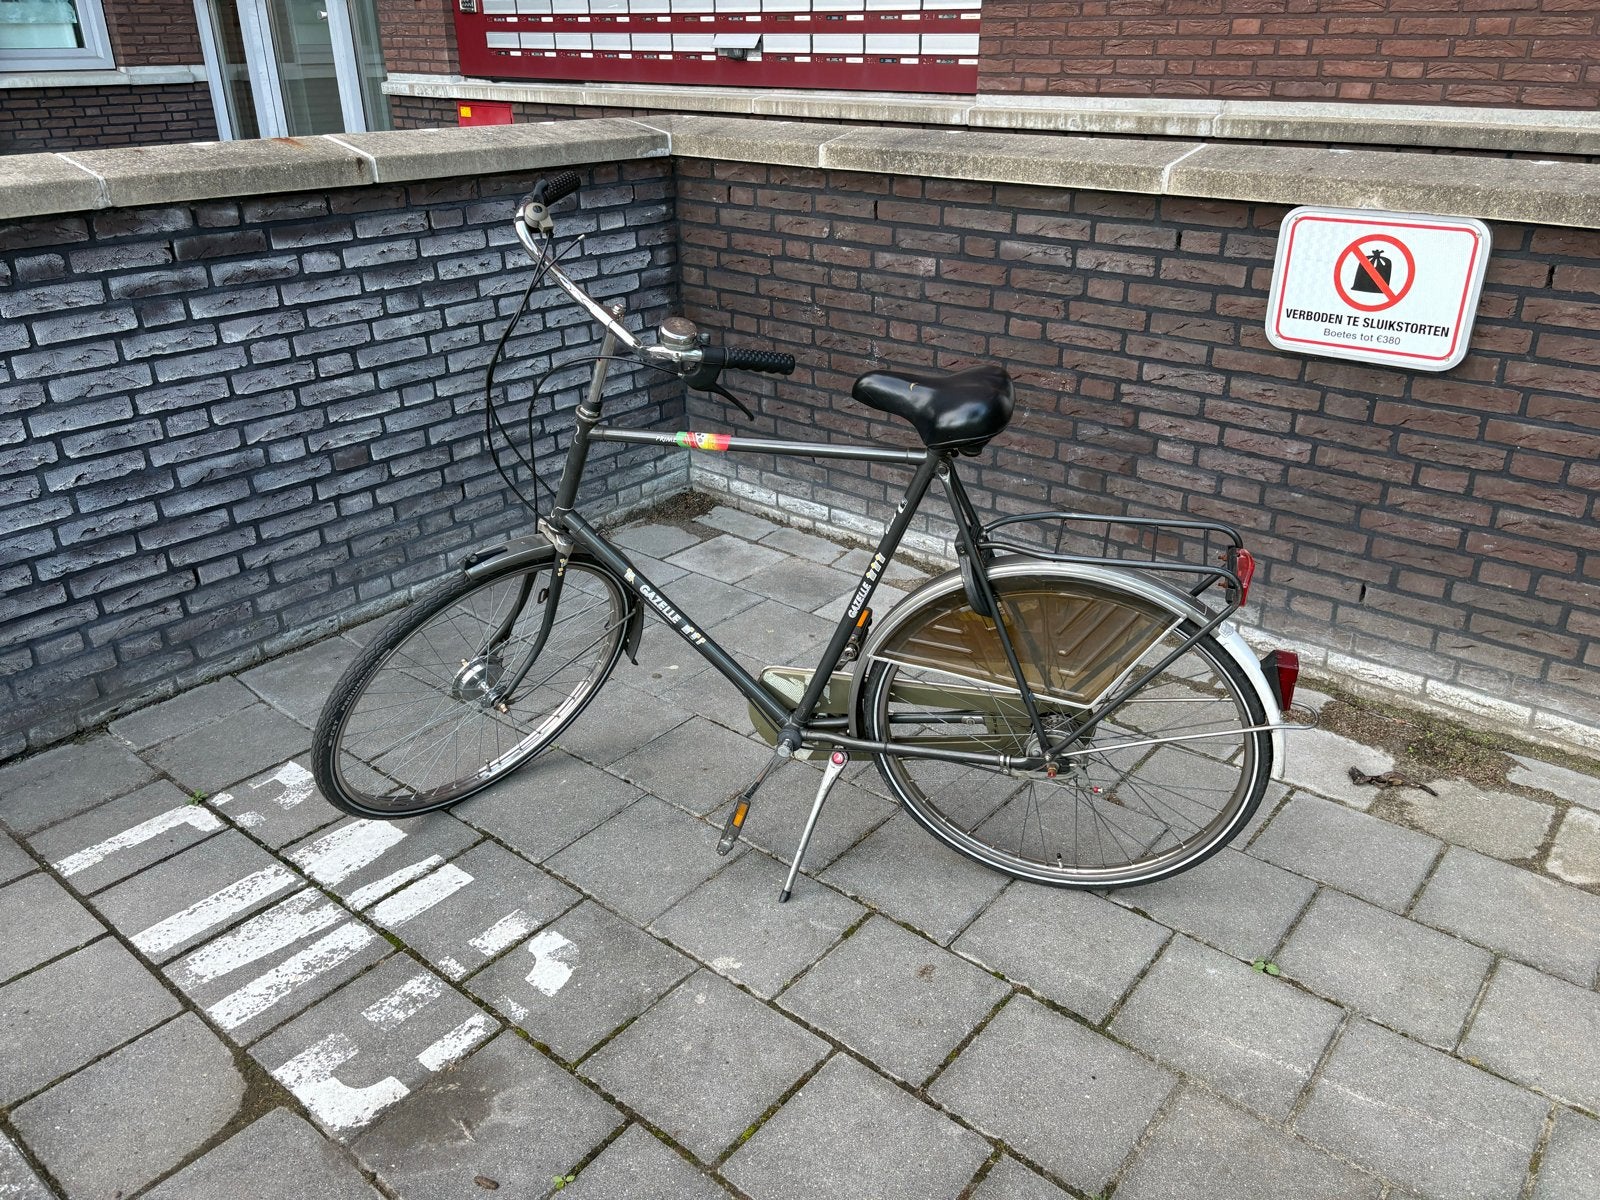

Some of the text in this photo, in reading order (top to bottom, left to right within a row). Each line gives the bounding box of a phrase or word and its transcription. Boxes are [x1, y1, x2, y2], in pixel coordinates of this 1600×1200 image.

[1285, 308, 1450, 337] VERBODEN TE SLUIKSTORTEN
[1323, 328, 1401, 346] Boetes tot €380
[639, 584, 682, 624] GAZELLE
[848, 581, 872, 619] GAZELLE
